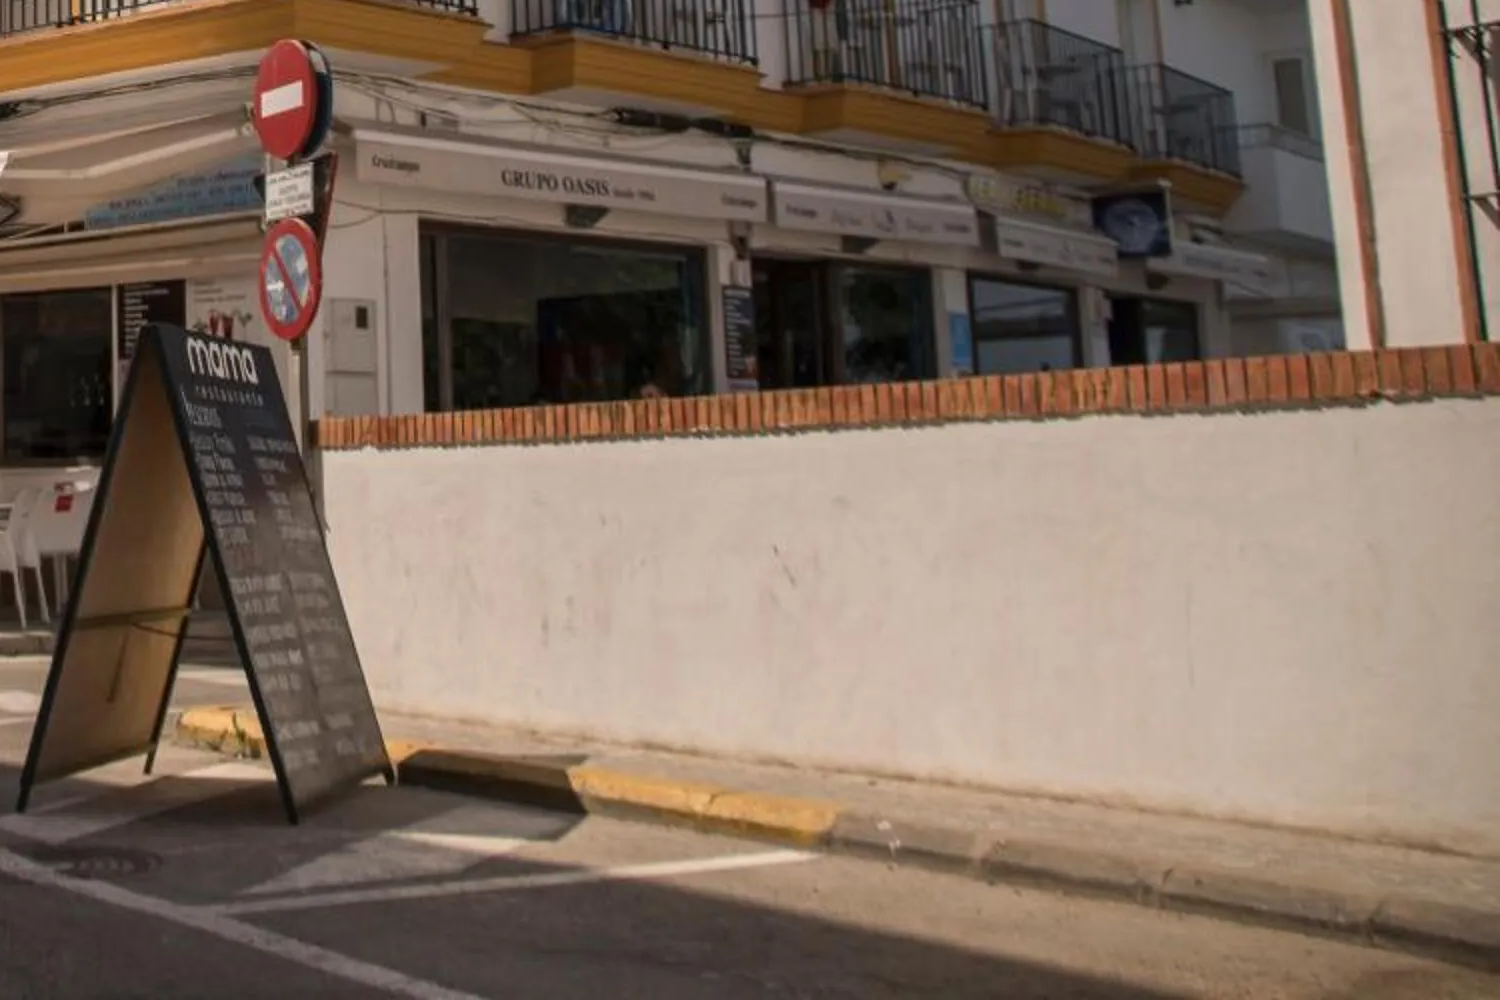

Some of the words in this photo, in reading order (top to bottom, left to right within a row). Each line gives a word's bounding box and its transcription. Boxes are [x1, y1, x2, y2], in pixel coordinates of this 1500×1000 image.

[501, 169, 559, 191] GRUPO
[562, 175, 610, 197] OASIS
[186, 337, 260, 386] mama
